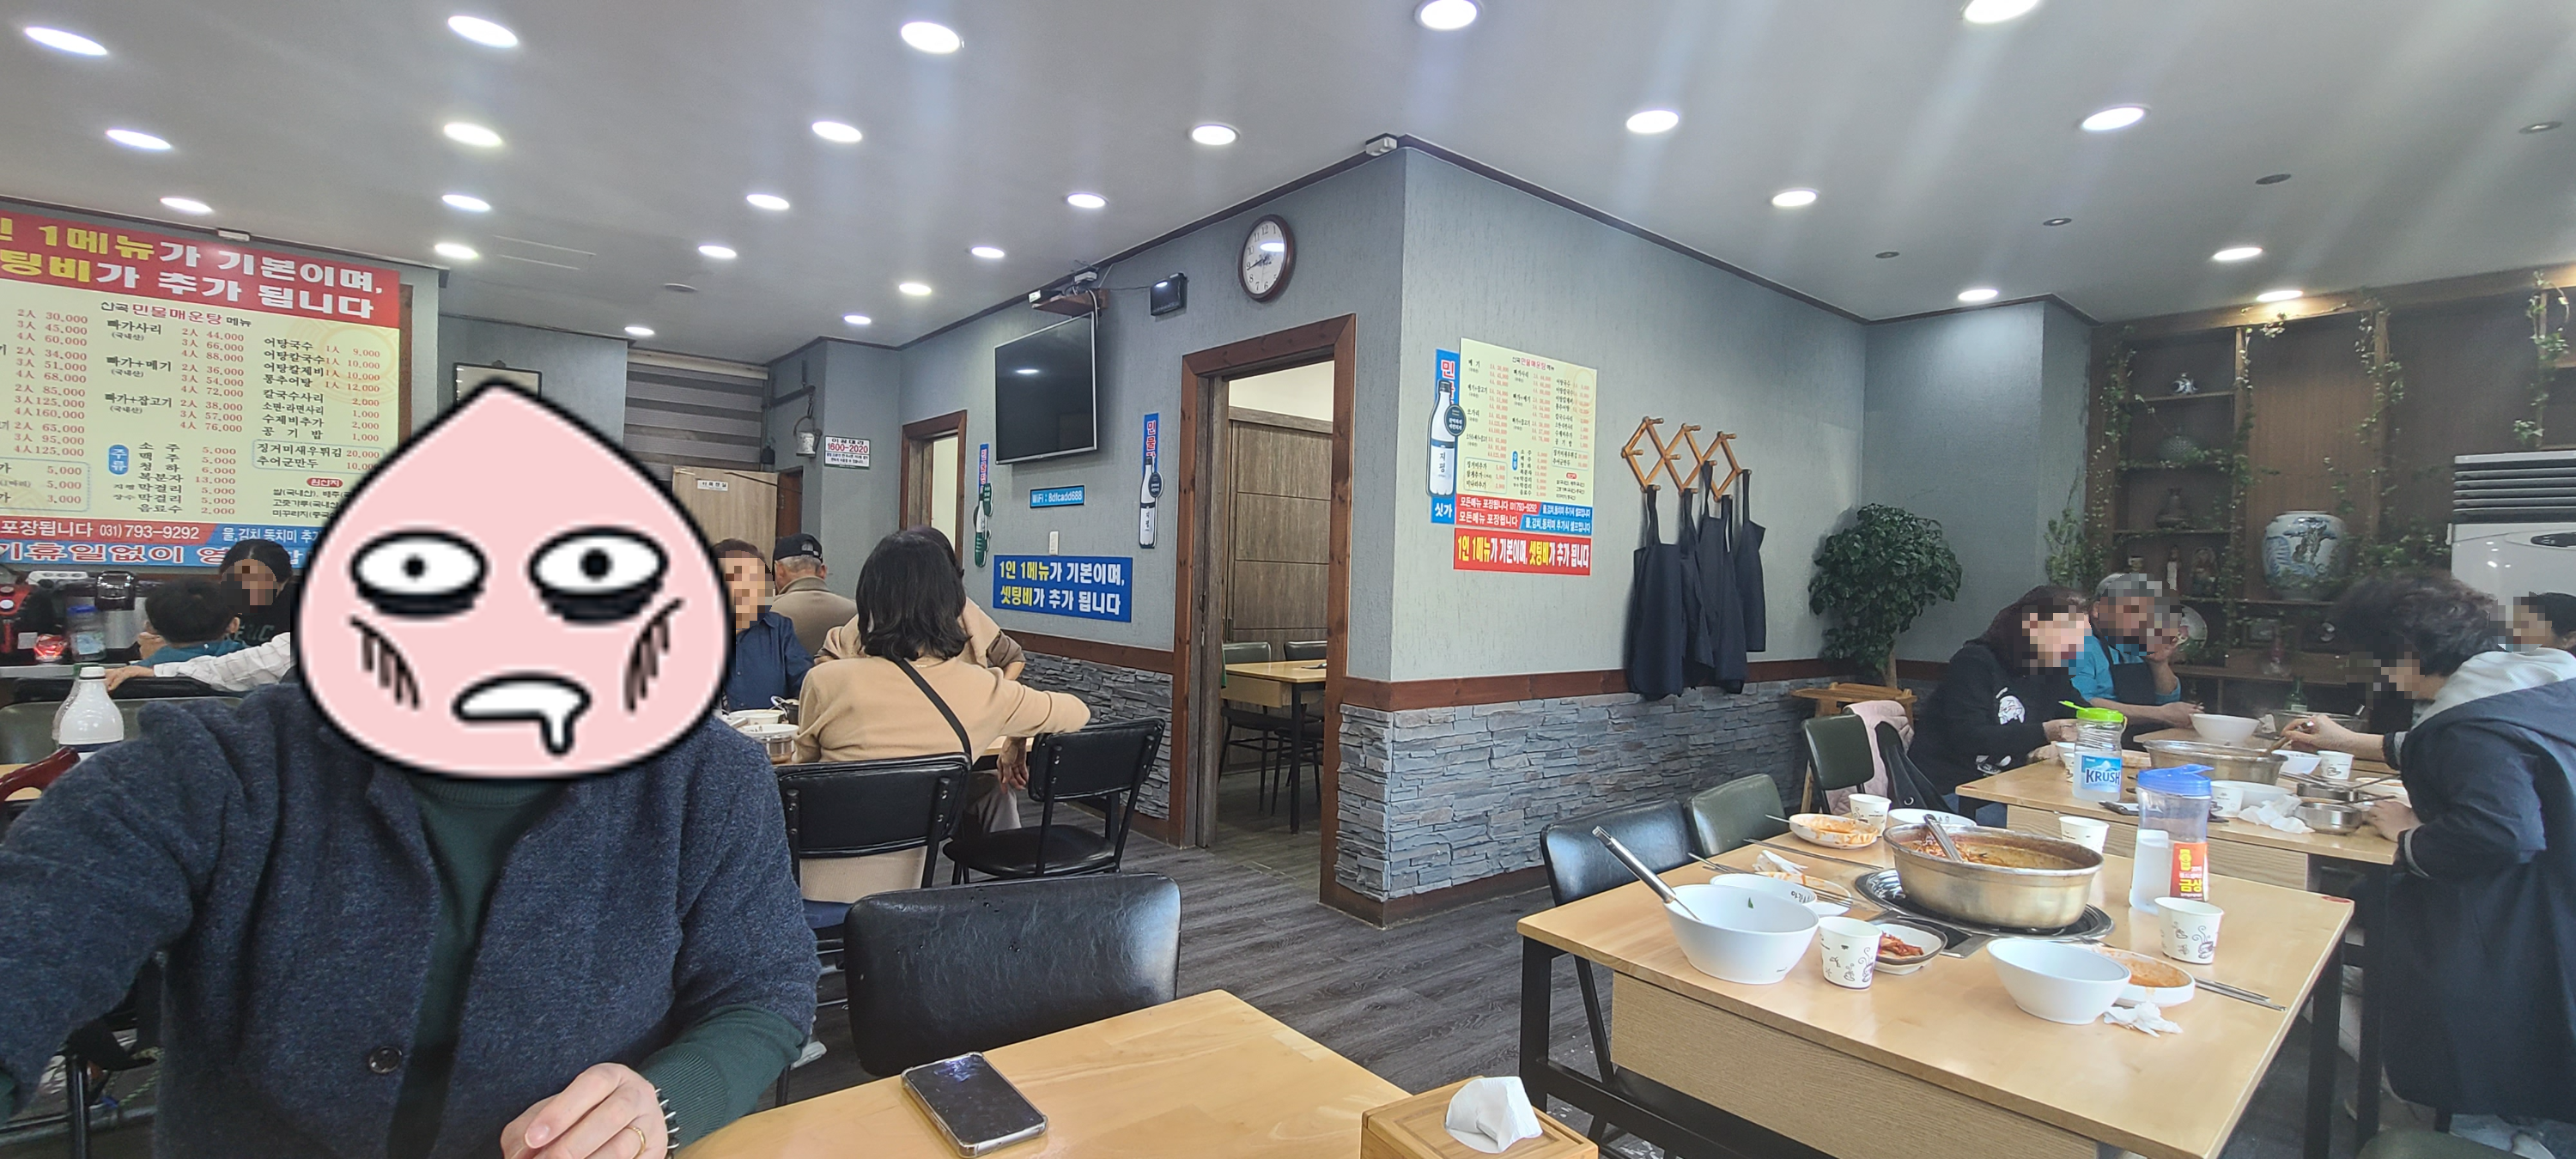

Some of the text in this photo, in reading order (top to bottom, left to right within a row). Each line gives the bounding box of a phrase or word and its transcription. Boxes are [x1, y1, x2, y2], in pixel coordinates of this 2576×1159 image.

[39, 226, 201, 267] 1메뉴가
[218, 251, 382, 294] 기본이며,
[159, 272, 241, 301] 추가
[258, 284, 374, 319] 됩니다
[132, 304, 222, 325] 민물매운탕
[226, 317, 252, 327] 메뉴
[828, 443, 868, 453] 1600-2020
[1435, 502, 1453, 518] 싯가
[1459, 511, 1485, 525] 모든메뉴
[1487, 513, 1518, 527] 포장됩니다
[1, 520, 93, 538] 포장됩니다
[1457, 535, 1470, 561] 1인
[1472, 536, 1498, 563] 1메뉴가
[1529, 540, 1556, 566] 셋팅비가
[1557, 542, 1570, 567] 추가
[1571, 543, 1589, 568] 됩니다
[999, 561, 1125, 586] 1인 1메뉴가 기본이며,
[1000, 586, 1121, 616] 셋팅비가 추가 됩니다
[2086, 768, 2120, 785] KRUSH
[2179, 878, 2202, 892] 금상
